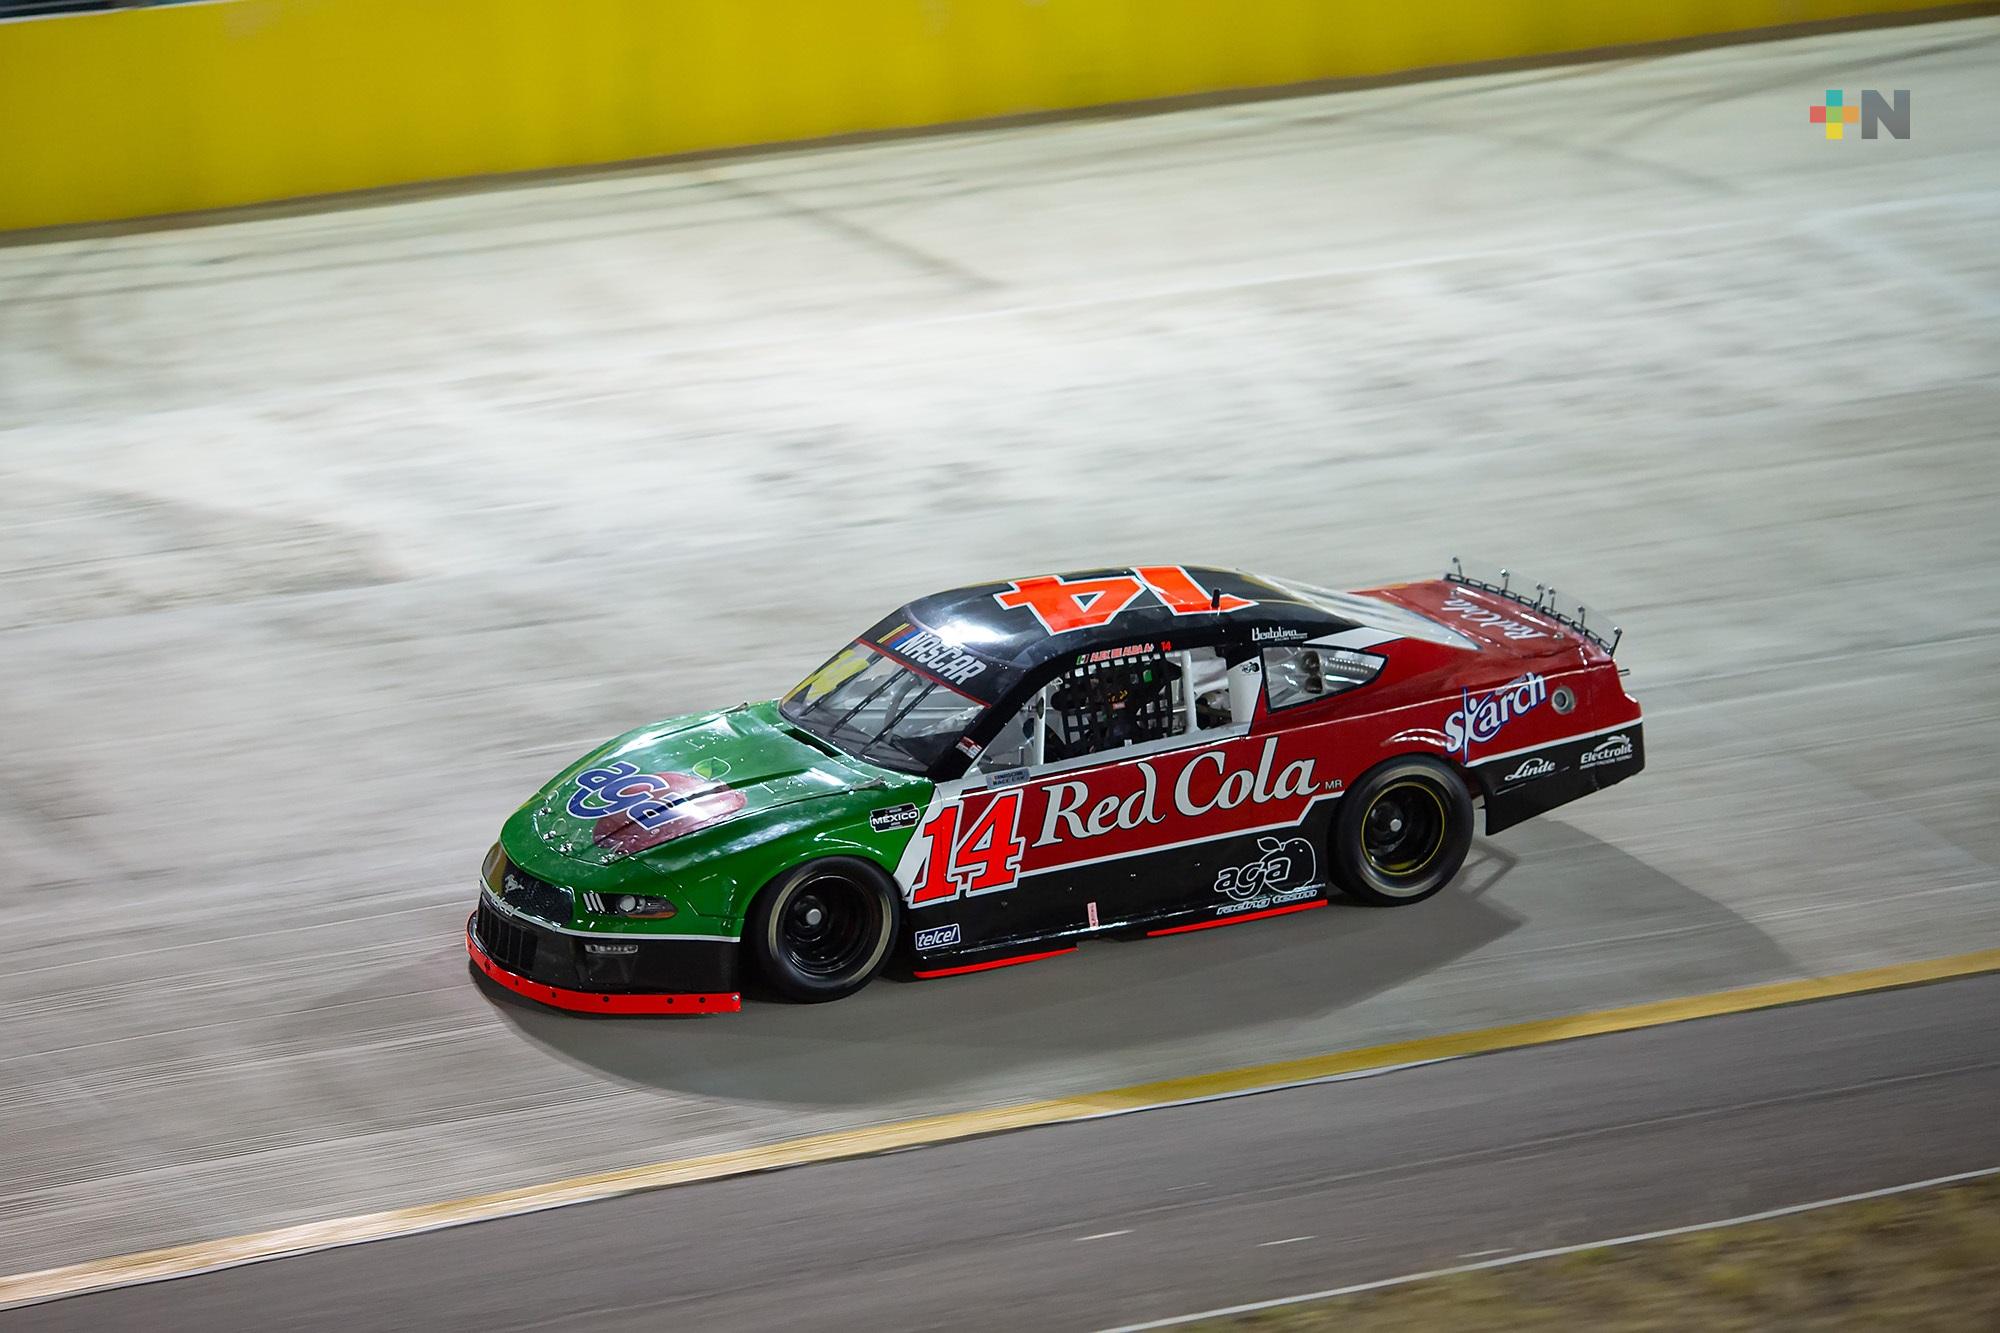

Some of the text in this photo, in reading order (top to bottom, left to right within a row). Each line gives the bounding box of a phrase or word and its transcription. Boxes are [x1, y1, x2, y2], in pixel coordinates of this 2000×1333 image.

[993, 565, 1259, 637] 14
[894, 631, 987, 685] NASCAR
[1161, 641, 1171, 651] 14
[1504, 757, 1556, 781] Linde
[1032, 736, 1344, 848] Red Cola MR
[872, 811, 918, 825] MEXICO
[908, 788, 1026, 909] 14
[1214, 856, 1291, 901] aga
[917, 926, 957, 948] telcel
